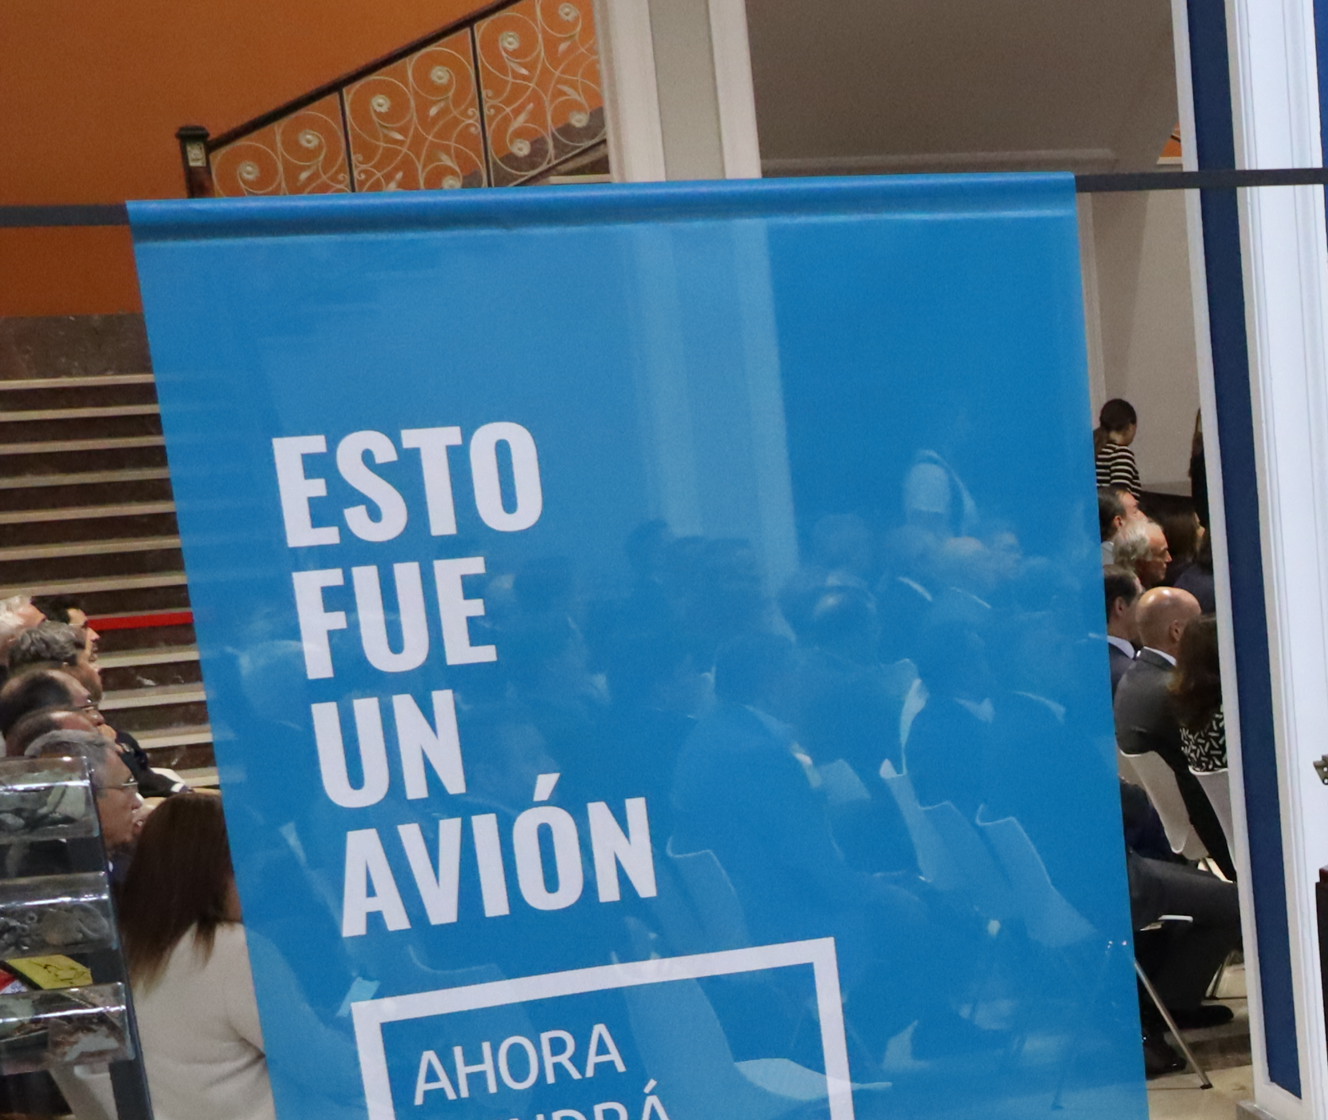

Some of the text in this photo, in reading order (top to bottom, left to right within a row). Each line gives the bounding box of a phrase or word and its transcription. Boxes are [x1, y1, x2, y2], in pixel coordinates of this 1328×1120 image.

[272, 421, 544, 548] ESTO
[291, 556, 498, 681] FUE
[309, 688, 466, 809] UN
[341, 772, 657, 939] AVIÓN
[412, 1022, 627, 1106] AHORA
